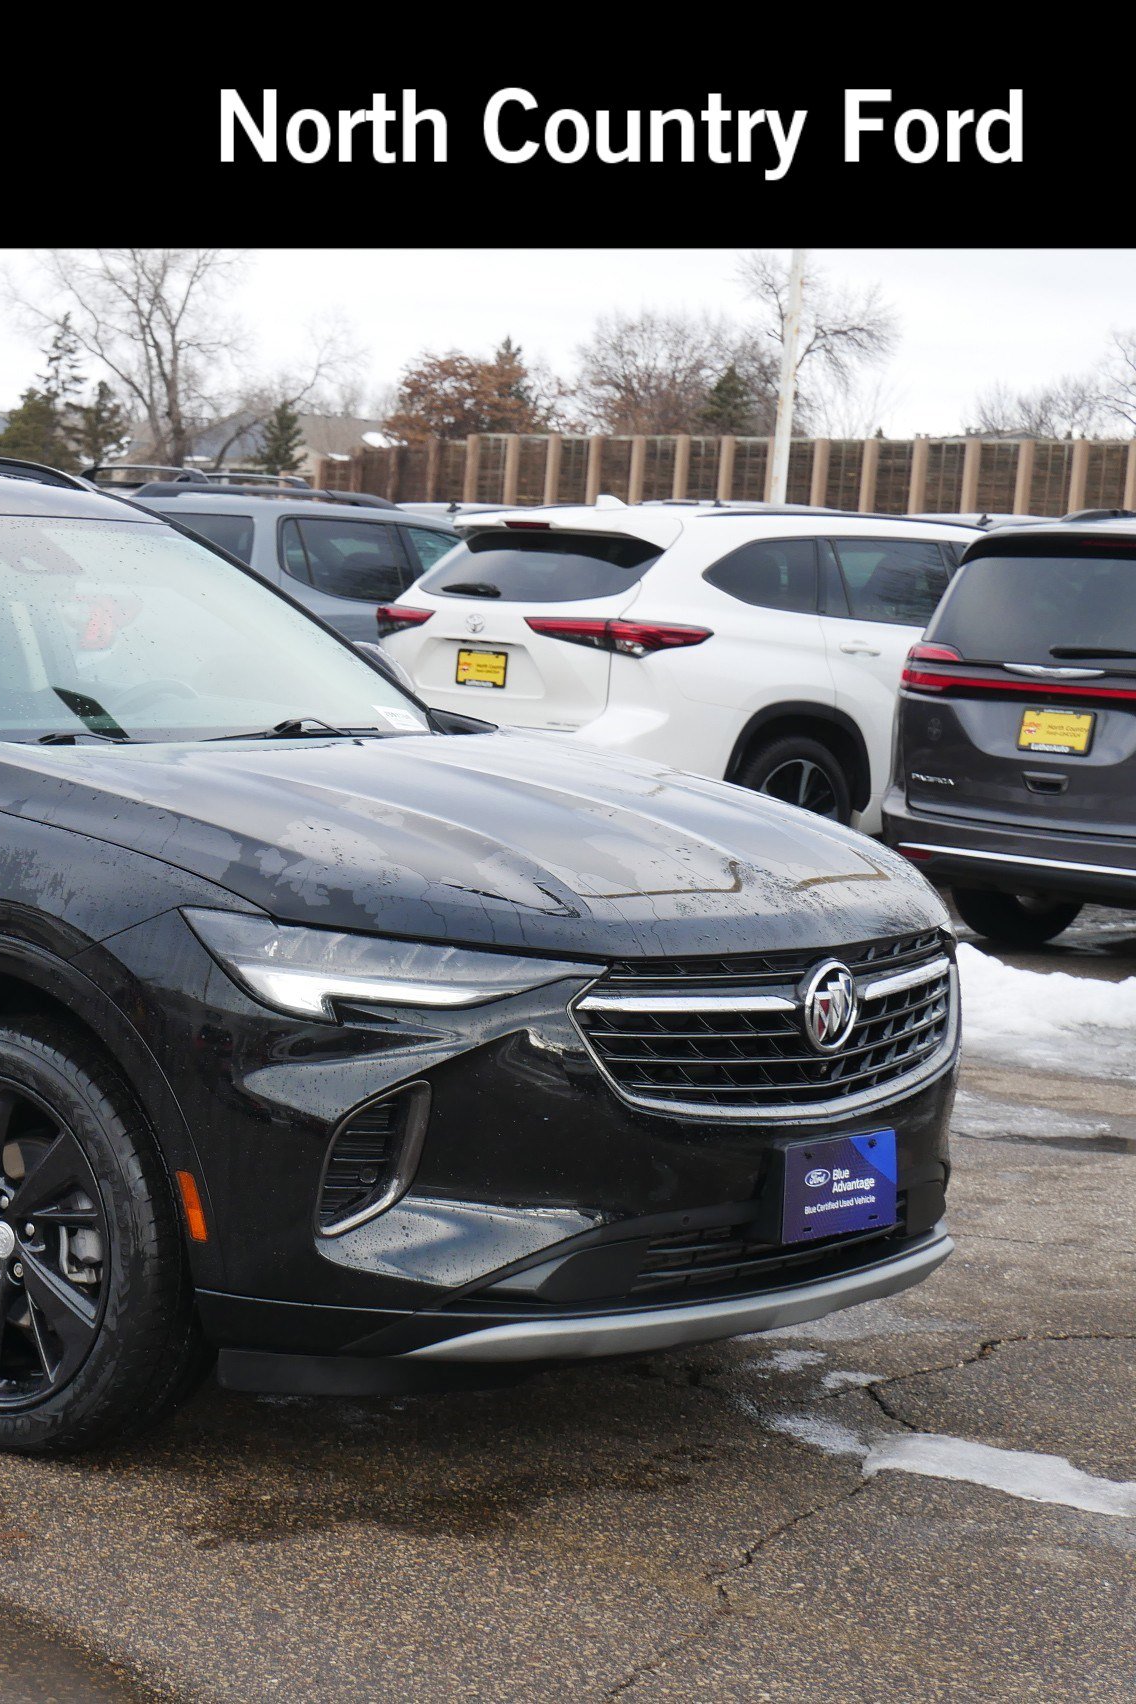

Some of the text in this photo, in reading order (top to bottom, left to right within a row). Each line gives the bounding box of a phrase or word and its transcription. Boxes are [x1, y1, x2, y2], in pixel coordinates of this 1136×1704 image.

[832, 1168, 850, 1180] Blue
[832, 1178, 875, 1193] Advantage
[804, 1195, 876, 1214] Blue Certified Used Vehicle
